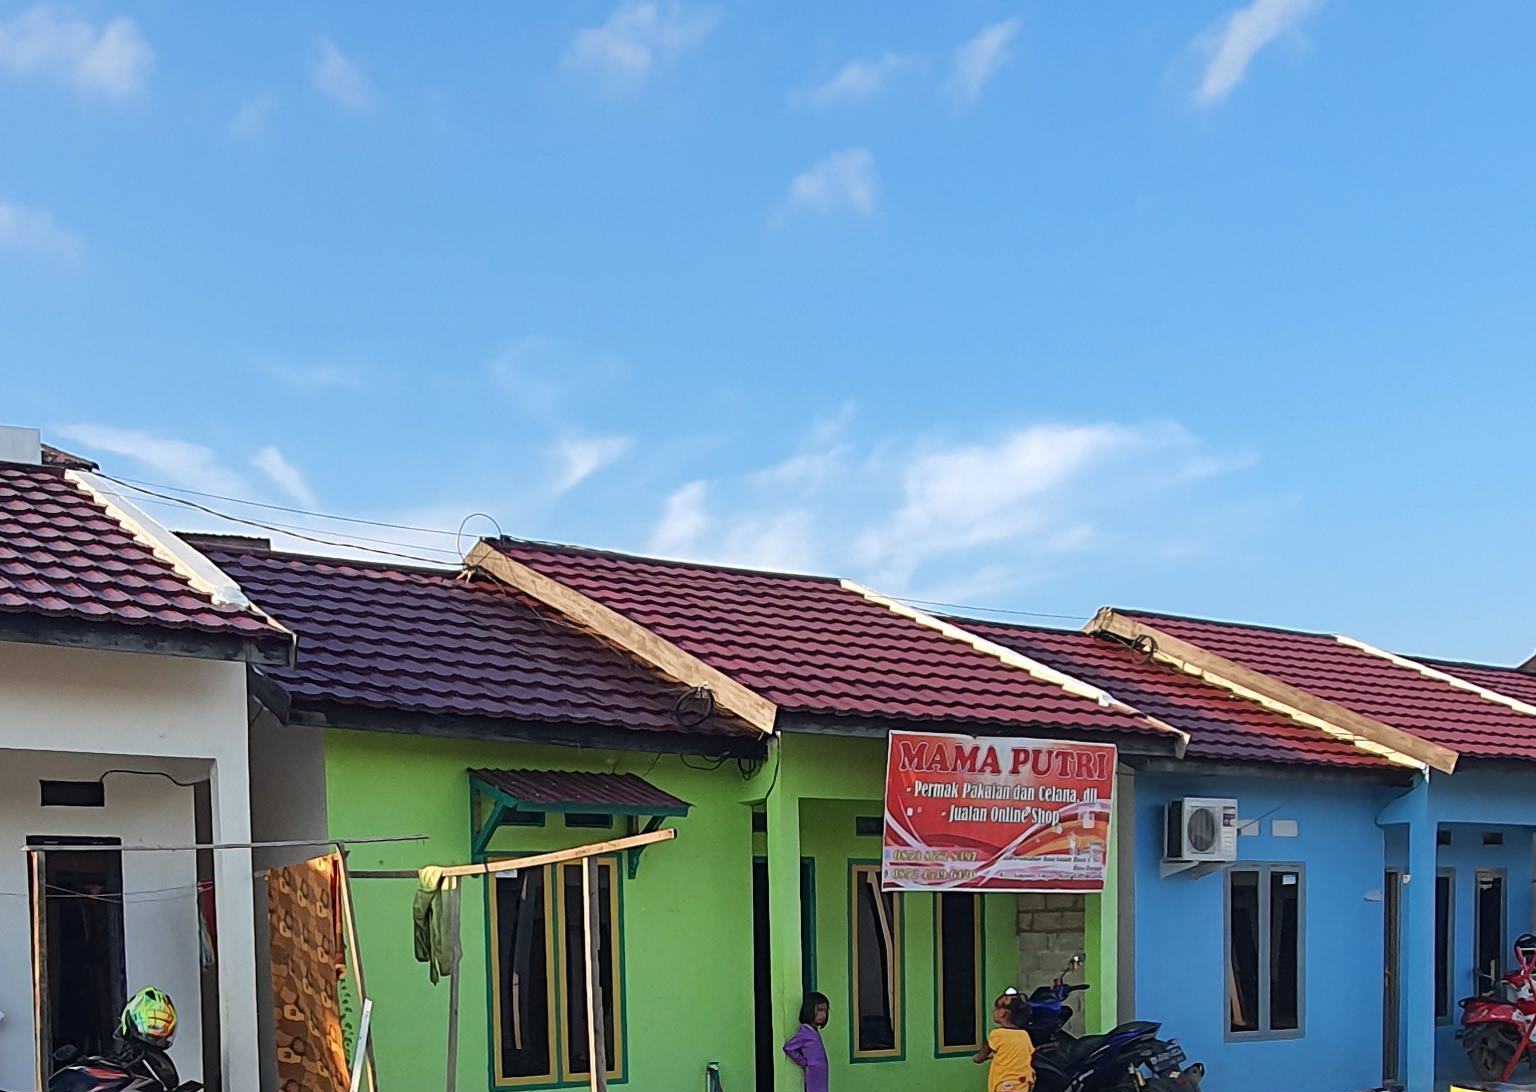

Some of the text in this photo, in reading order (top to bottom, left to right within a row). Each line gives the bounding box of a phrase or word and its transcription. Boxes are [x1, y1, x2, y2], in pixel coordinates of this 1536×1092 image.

[899, 741, 1108, 780] MAMA PUTRI
[914, 780, 958, 798] Permak
[962, 782, 1010, 800] Pakaian
[1013, 784, 1035, 801] dan
[949, 804, 1059, 826] Jualan Online Shop
